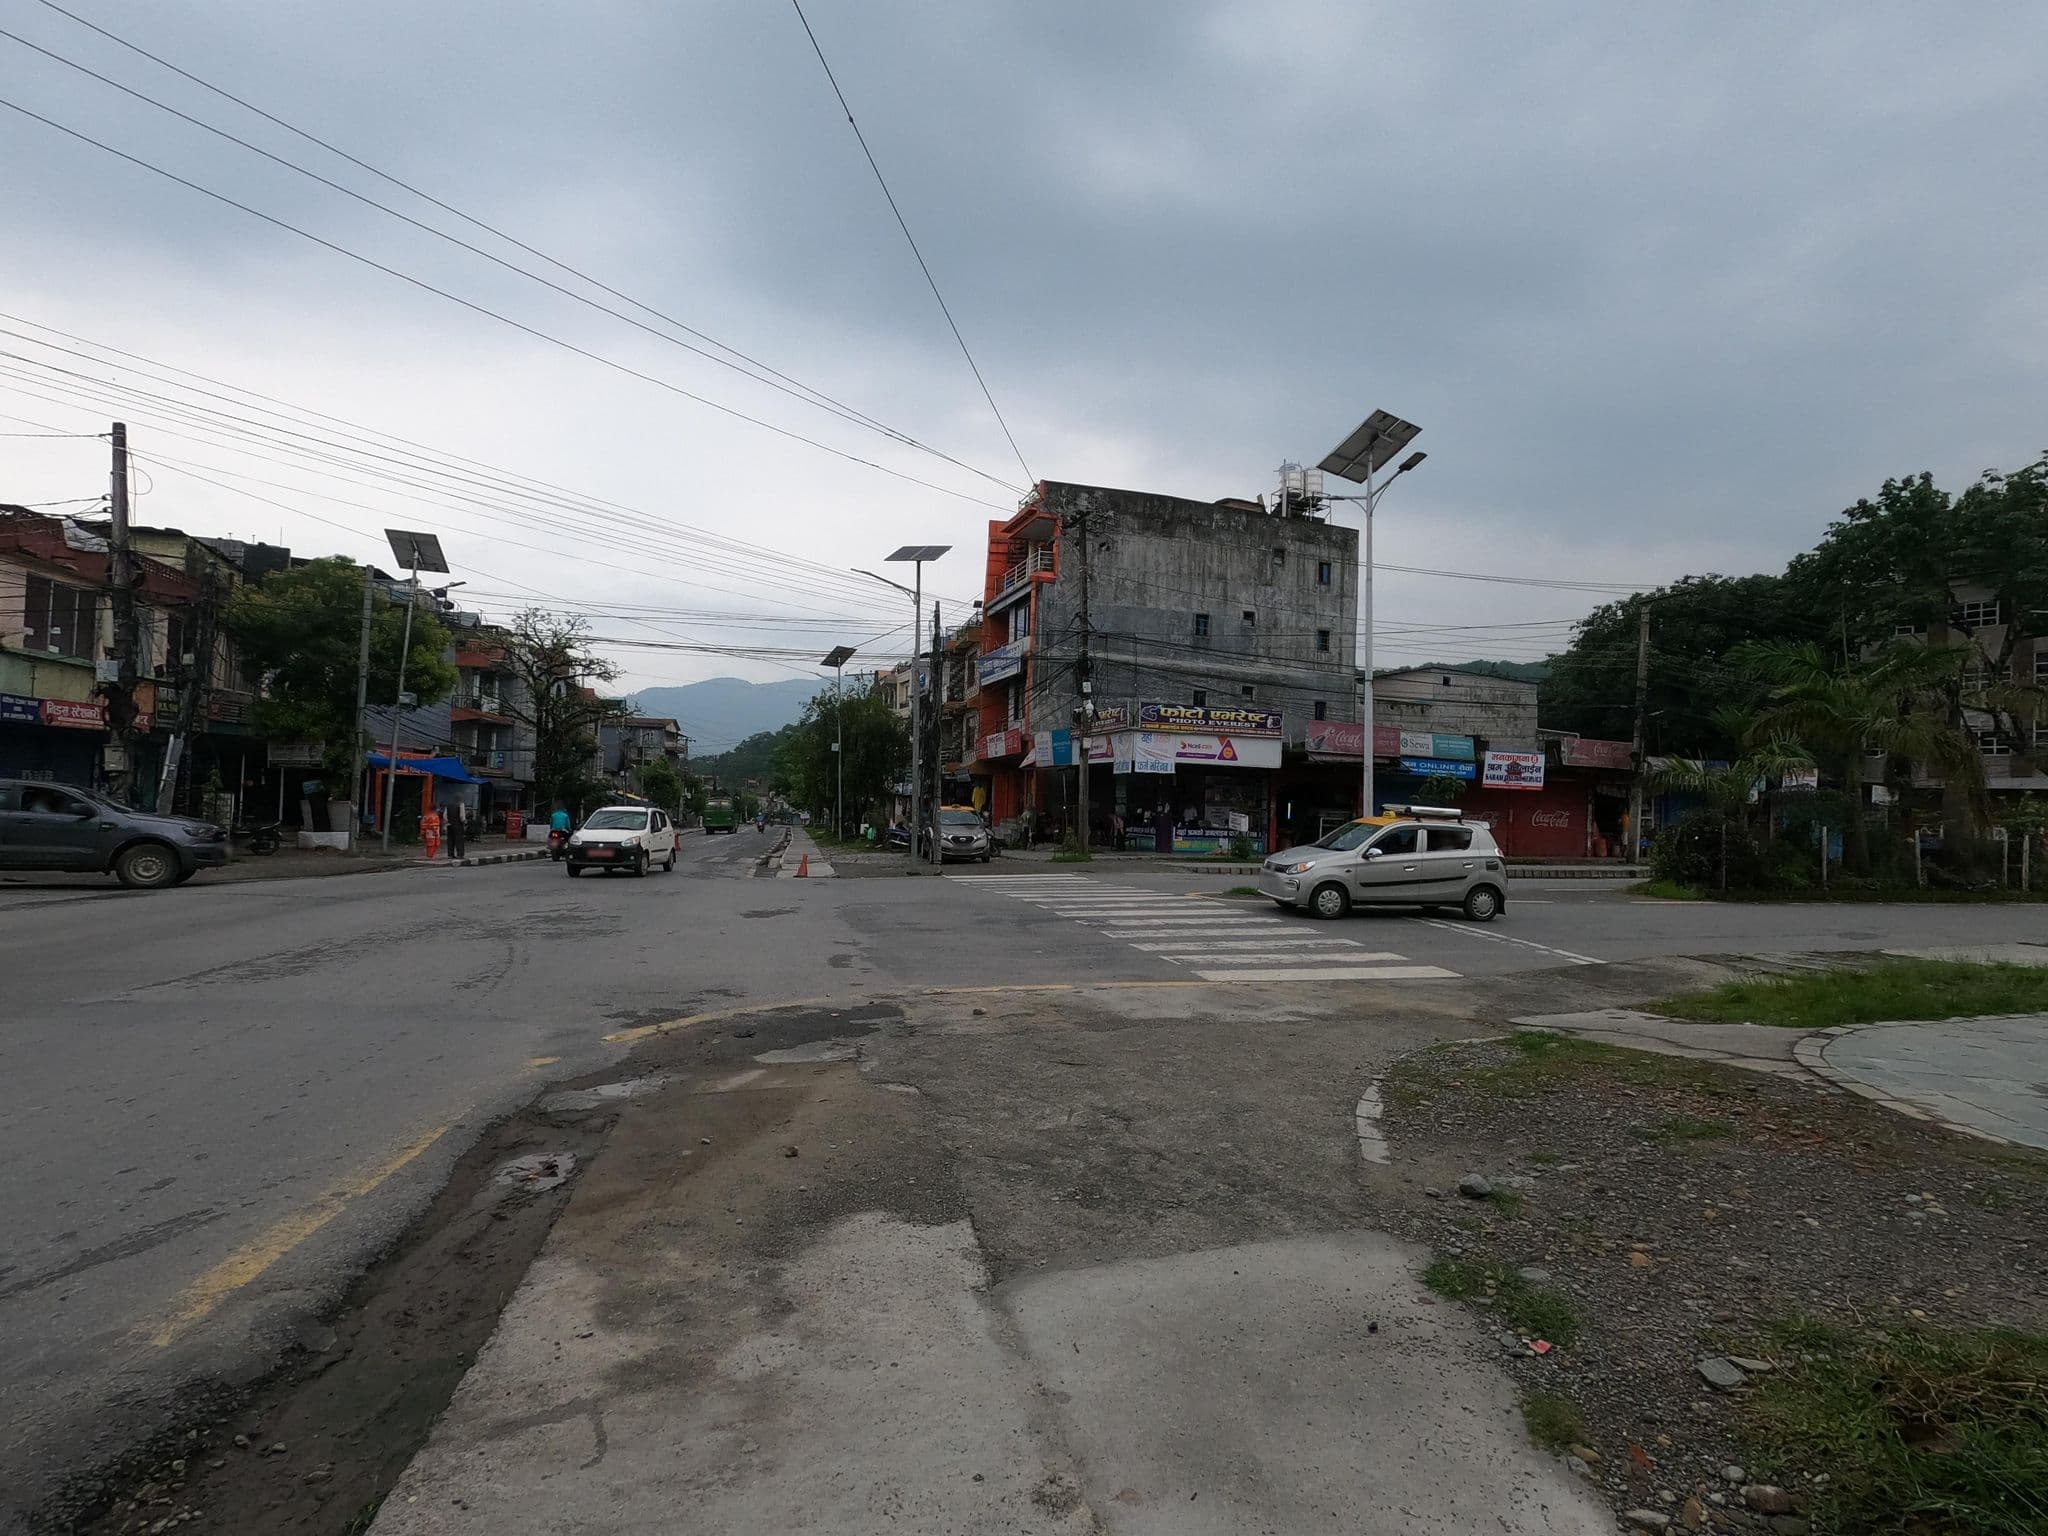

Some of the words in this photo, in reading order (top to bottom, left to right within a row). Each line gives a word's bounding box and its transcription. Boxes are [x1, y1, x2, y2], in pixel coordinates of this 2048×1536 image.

[1159, 705, 1206, 720] फोटो
[1169, 718, 1206, 726] PHOTO
[1208, 720, 1258, 728] EVEREST
[1419, 762, 1456, 770] ONLINE
[1532, 809, 1569, 828] Coca-Cola
